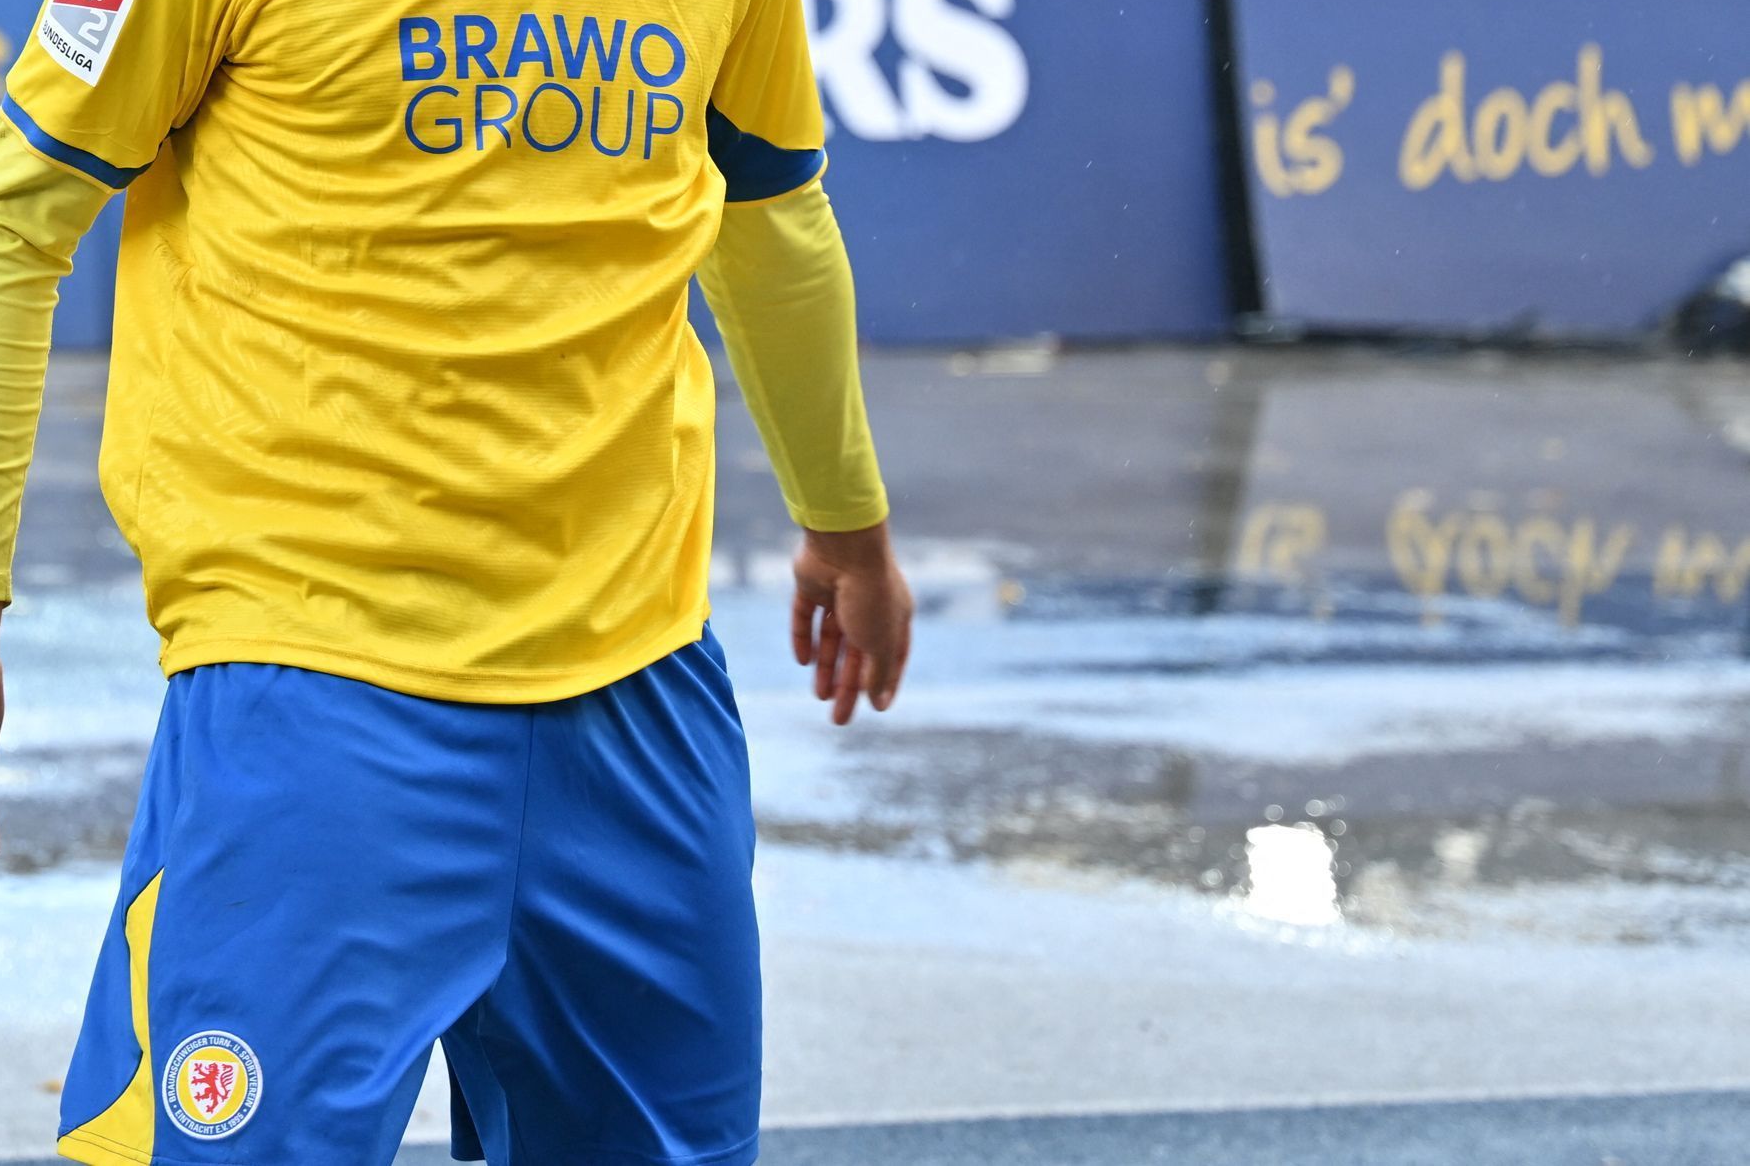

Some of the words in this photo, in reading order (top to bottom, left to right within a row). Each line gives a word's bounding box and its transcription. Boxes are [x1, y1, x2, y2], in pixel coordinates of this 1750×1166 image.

[398, 13, 686, 88] BRAWO
[404, 82, 684, 160] GROUP
[1397, 40, 1656, 194] doch
[168, 1037, 208, 1104] BRAUNSCHWEIGER
[208, 1036, 233, 1048] TURN-
[239, 1050, 258, 1108] SPORTVEREIN
[174, 1109, 215, 1134] EINTRACHT
